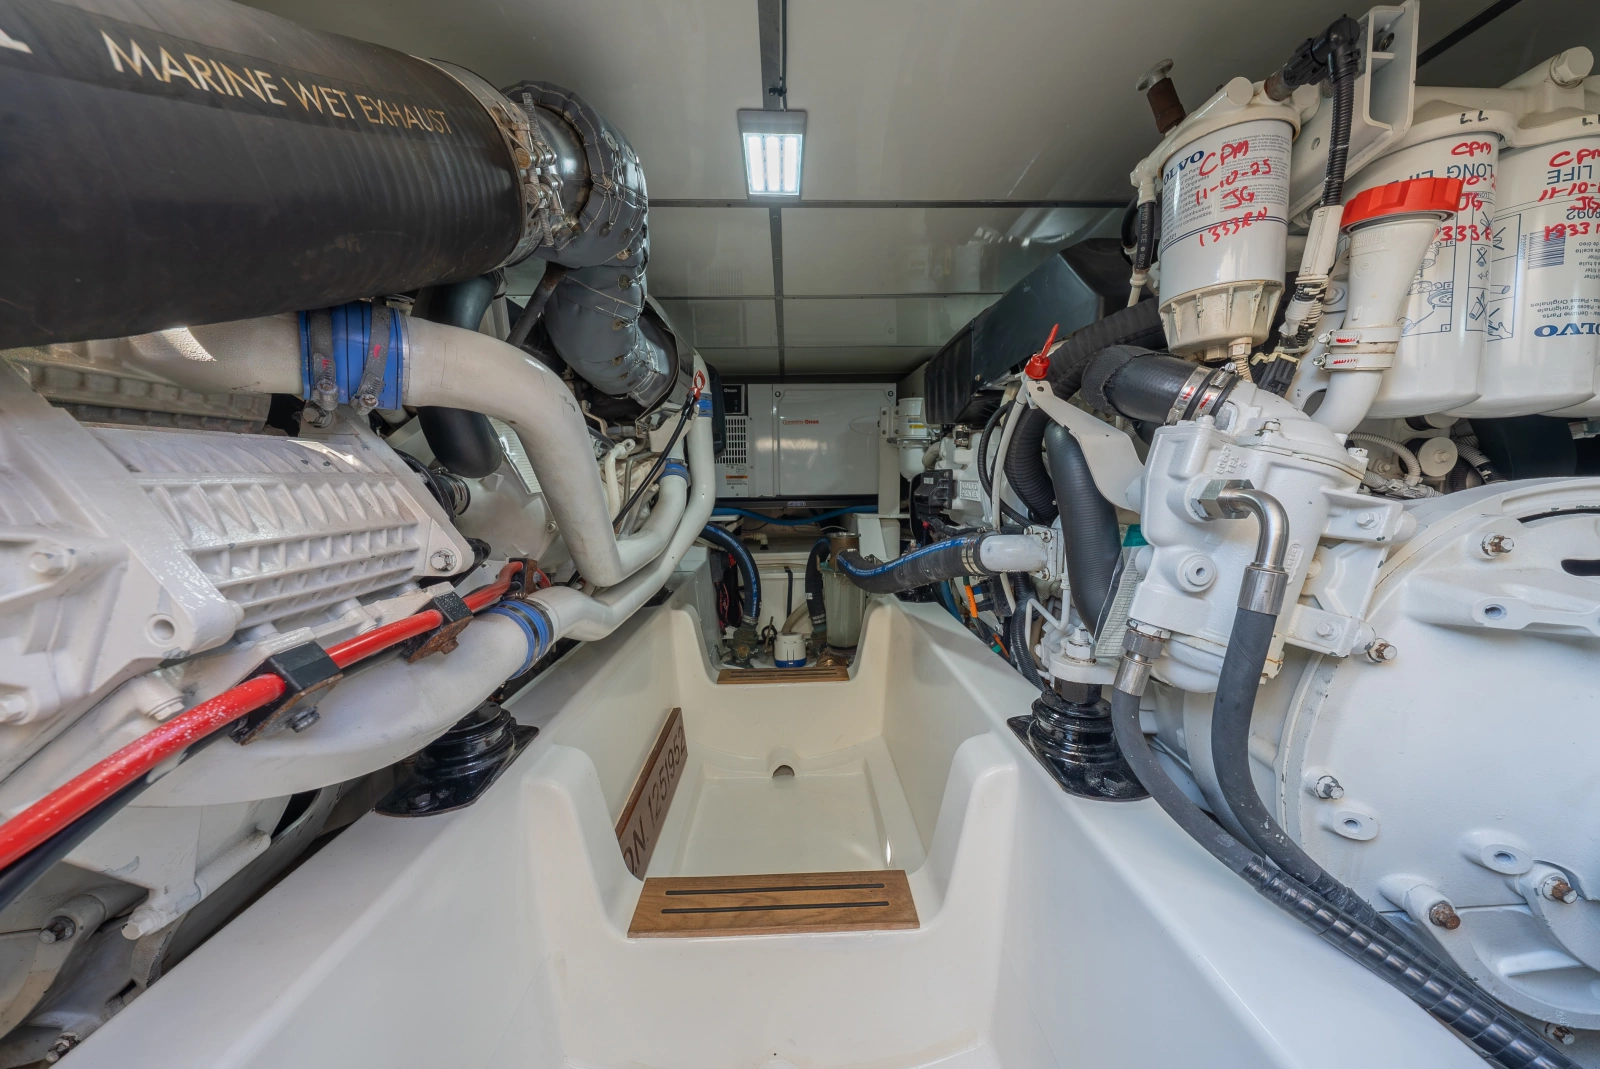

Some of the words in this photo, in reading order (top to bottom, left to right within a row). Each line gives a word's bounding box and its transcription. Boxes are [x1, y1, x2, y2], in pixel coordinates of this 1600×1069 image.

[100, 29, 287, 107] MARINE
[282, 76, 356, 119] WET
[359, 94, 453, 135] EXHAUST
[1198, 140, 1250, 177] CPM
[1195, 158, 1272, 205] 11-10-25
[1547, 165, 1592, 185] LIFE
[1220, 186, 1255, 211] JG
[1537, 181, 1600, 202] 11-10-
[1534, 323, 1600, 338] LVO
